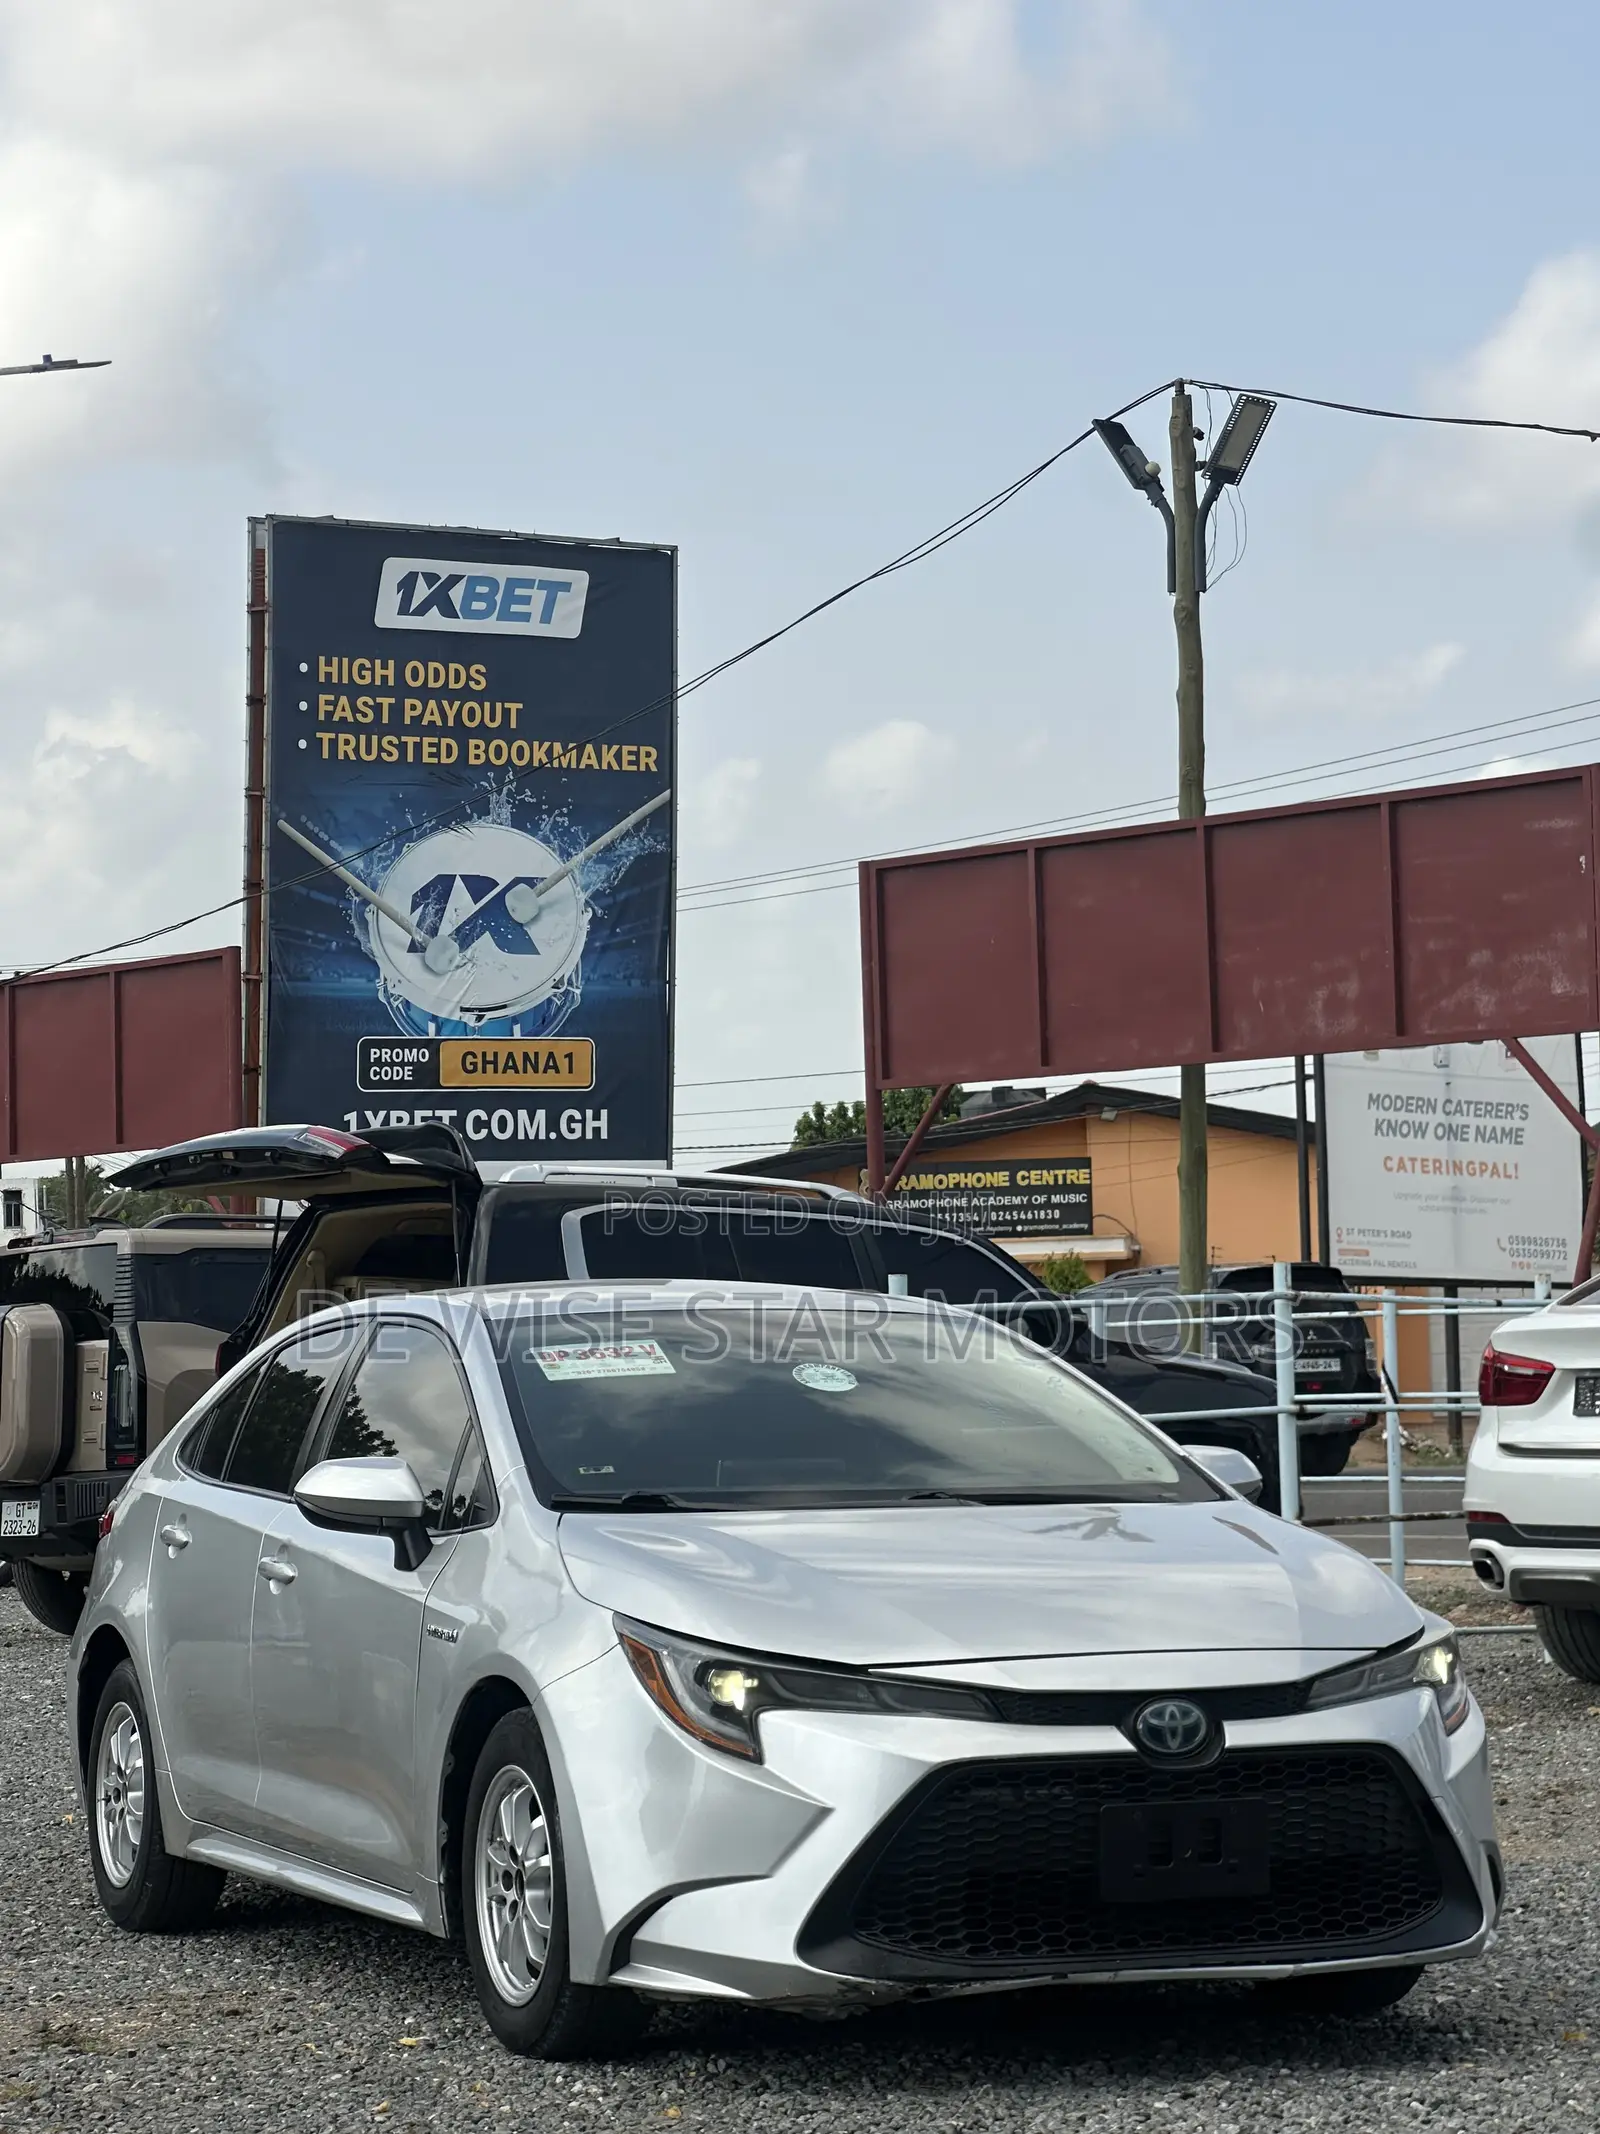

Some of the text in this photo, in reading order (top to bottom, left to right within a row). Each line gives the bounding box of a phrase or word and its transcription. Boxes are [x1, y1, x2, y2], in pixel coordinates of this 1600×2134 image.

[396, 571, 573, 625] 1XBET
[318, 655, 487, 692] HIGH ODDS
[317, 694, 523, 729] FAST PAYOUT
[316, 732, 659, 772] TRUSTED BOOKMAKER
[369, 1048, 575, 1076] PROMO GHANA1
[369, 1066, 413, 1082] CODE
[1367, 1092, 1530, 1122] MODERN CATERER'S
[343, 1108, 609, 1141] 1XBCOM.GH
[1374, 1118, 1525, 1147] KNOW ONE NAME
[886, 1168, 1091, 1190] RAMOPHONE CENTRE
[1383, 1155, 1520, 1180] CATERINGPAL!
[886, 1193, 1088, 1210] GRAMOPHONE ACADEMY OF MUSIC
[990, 1209, 1061, 1221] 0245461830
[638, 1343, 657, 1357] V
[16, 1503, 26, 1517] GT
[3, 1520, 36, 1535] 2323-26
